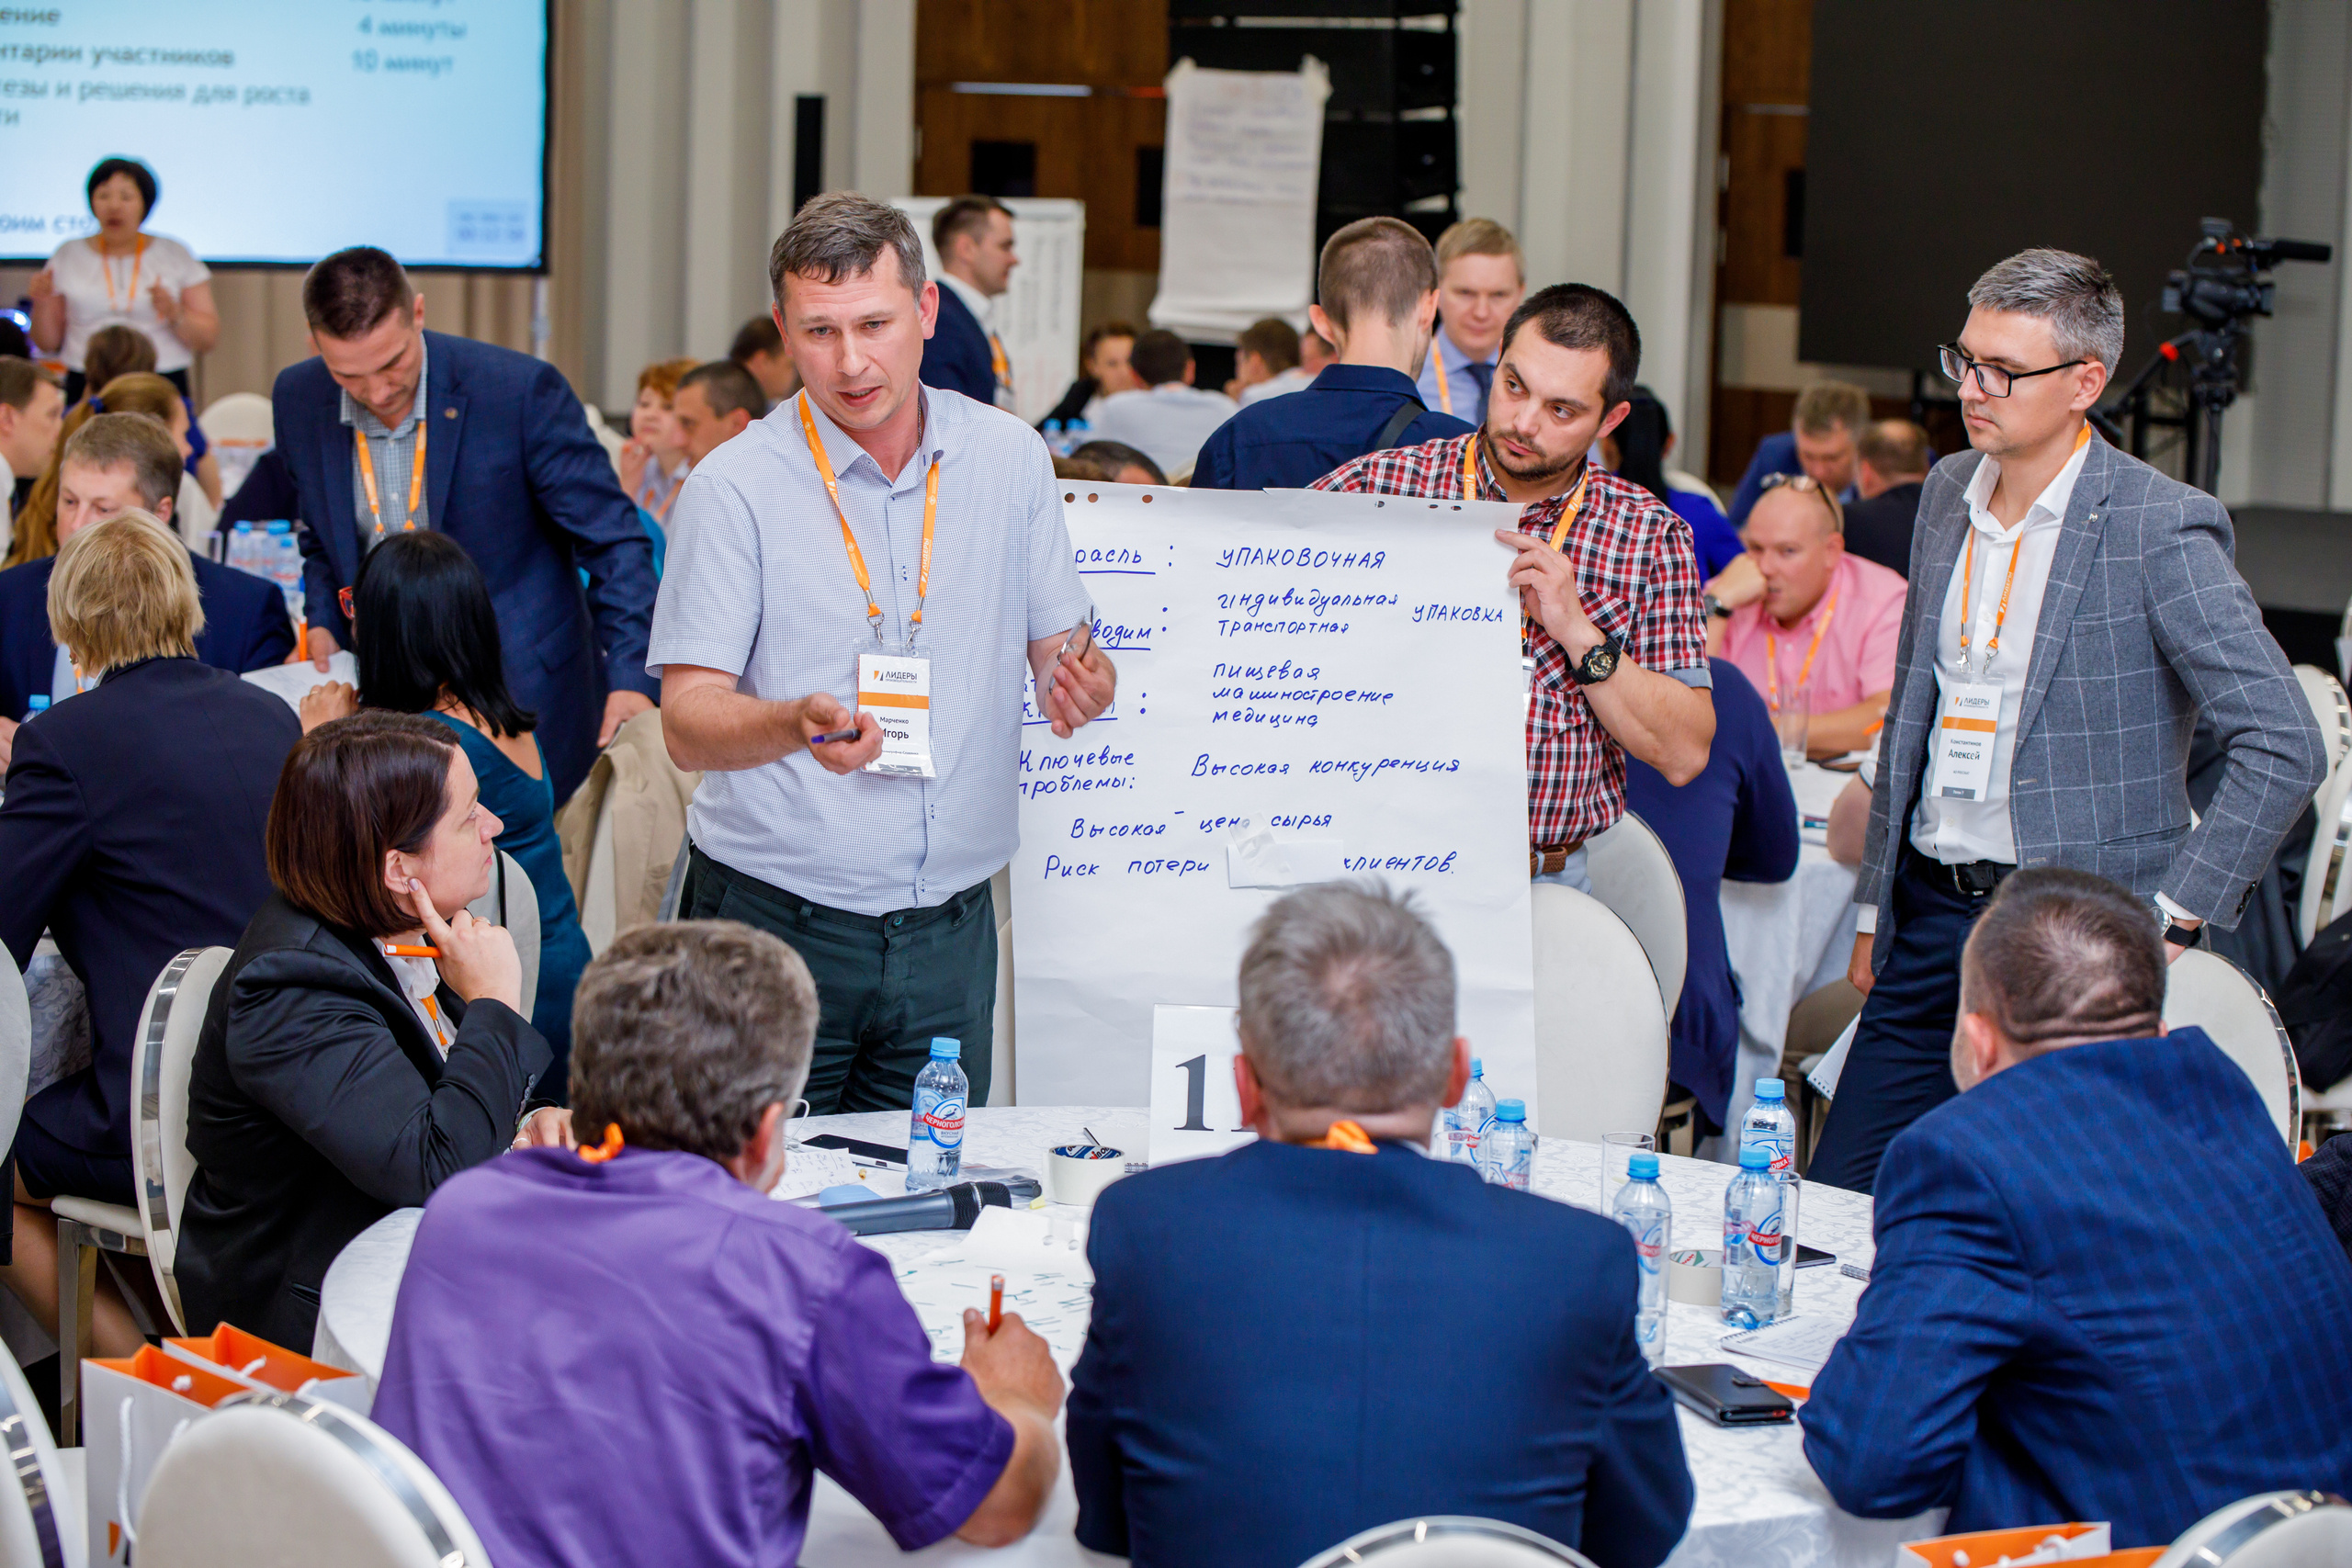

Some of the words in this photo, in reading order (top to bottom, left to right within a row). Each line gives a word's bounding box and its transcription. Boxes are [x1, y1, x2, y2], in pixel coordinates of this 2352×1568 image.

[89, 47, 235, 69] участников
[78, 81, 187, 105] решения
[190, 84, 237, 107] для
[241, 85, 312, 108] роста
[1075, 548, 1142, 564] расль
[1216, 547, 1386, 570] УПАКОВОЧНАЯ
[1412, 604, 1504, 623] УПАКОВКА
[1091, 618, 1152, 649] водим
[885, 671, 918, 681] ЛИДЕРЫ
[1964, 697, 1991, 705] ЛИДЕРЫ
[879, 716, 910, 725] Марченко
[1948, 749, 1981, 761] Алексей
[1191, 752, 1290, 777] Высокая
[1308, 758, 1461, 783] конкуренция
[1070, 818, 1167, 839] Высокая
[1271, 814, 1333, 830] сырья
[1044, 854, 1101, 880] Риск
[1127, 859, 1210, 877] потери
